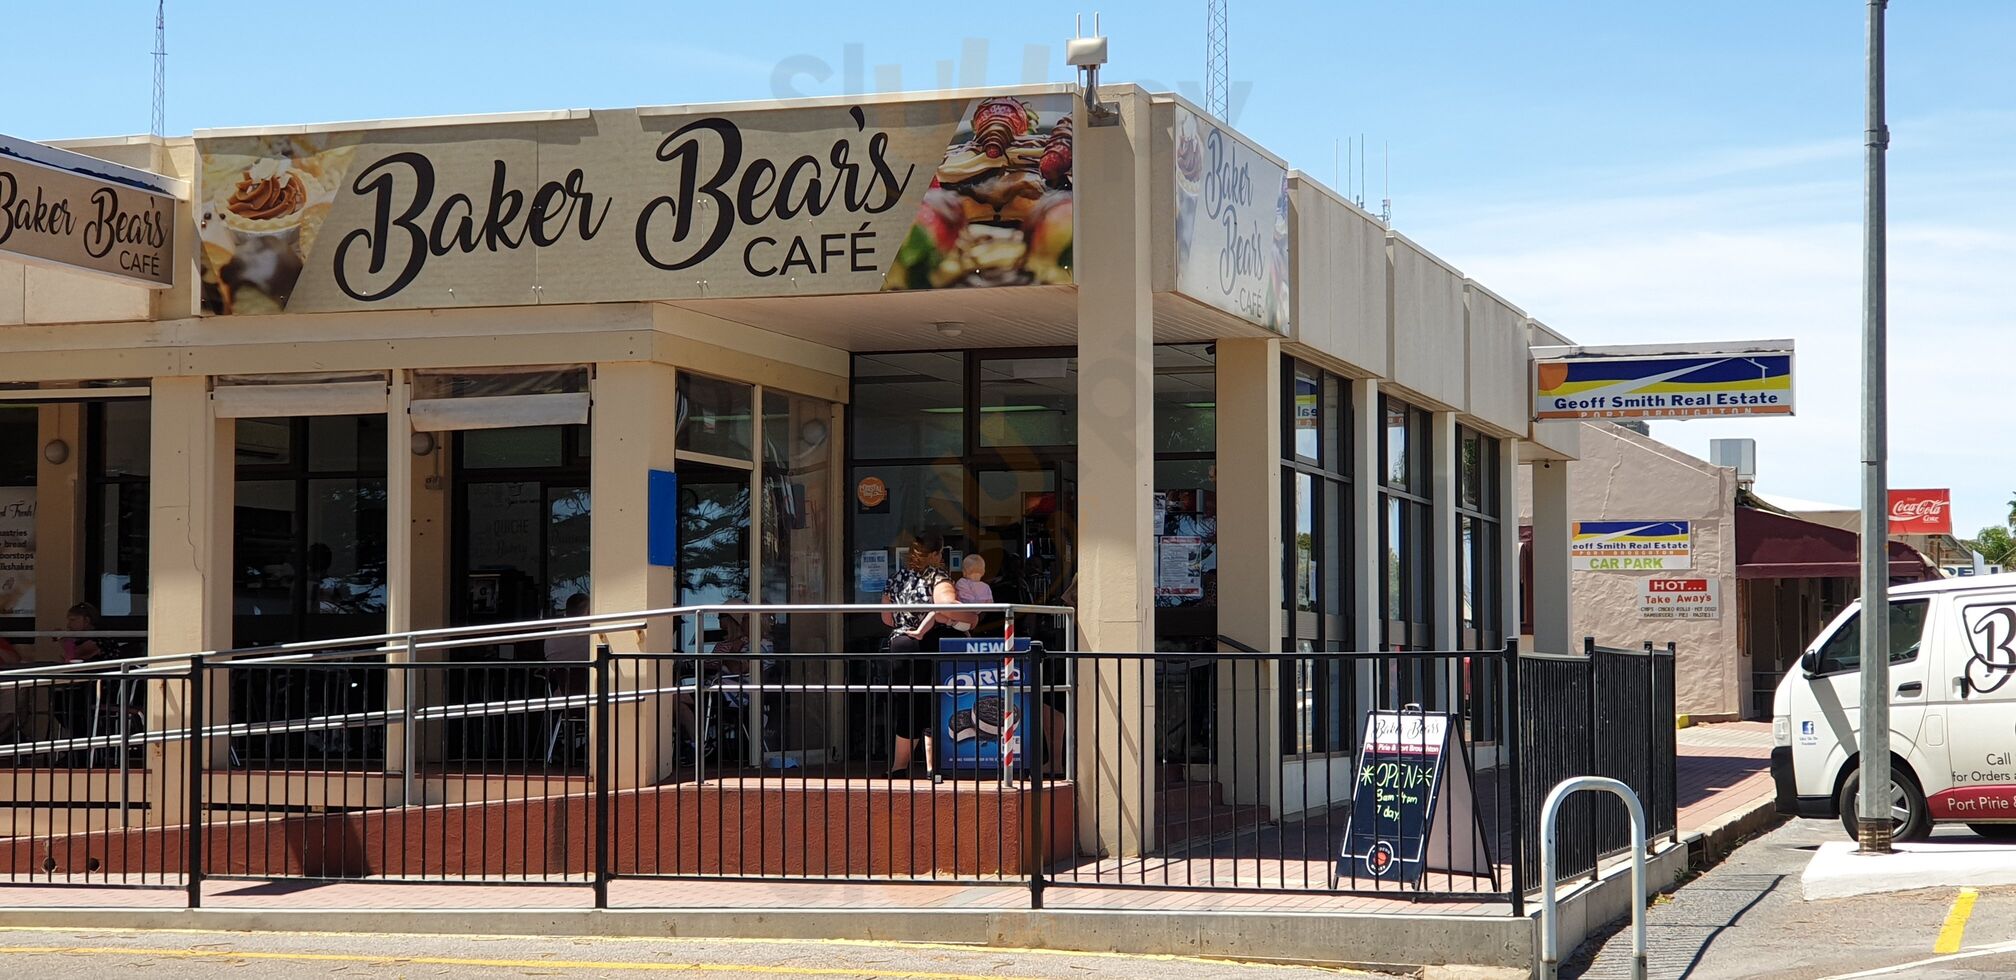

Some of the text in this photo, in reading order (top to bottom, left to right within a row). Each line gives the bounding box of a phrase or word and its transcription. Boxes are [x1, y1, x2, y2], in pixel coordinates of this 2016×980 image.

[1205, 127, 1254, 220] Baker
[333, 105, 915, 302] Baker Bear's
[83, 187, 168, 258] Bear's
[743, 222, 877, 278] CAFÉ
[1219, 204, 1266, 295] Bear's
[120, 250, 160, 276] CAFÉ
[1554, 391, 1778, 410] Geoff Smith Real Estate
[1642, 408, 1752, 417] BROUGHTON
[1892, 499, 1942, 515] Coca-Cola
[1572, 541, 1688, 550] eoff Smith Real Estate
[1589, 557, 1664, 569] CAR PARK
[1645, 593, 1712, 605] Take Away's
[966, 642, 1004, 653] NEW
[1371, 718, 1402, 739] Bak
[1378, 744, 1390, 752] Pirie
[1409, 745, 1439, 753] Brouhton
[1986, 752, 2012, 766] Call
[1376, 763, 1418, 789] OPEN
[1952, 770, 1967, 782] for
[1971, 770, 2011, 782] Orders
[1947, 797, 1977, 811] Port
[1978, 796, 2009, 810] Pirie
